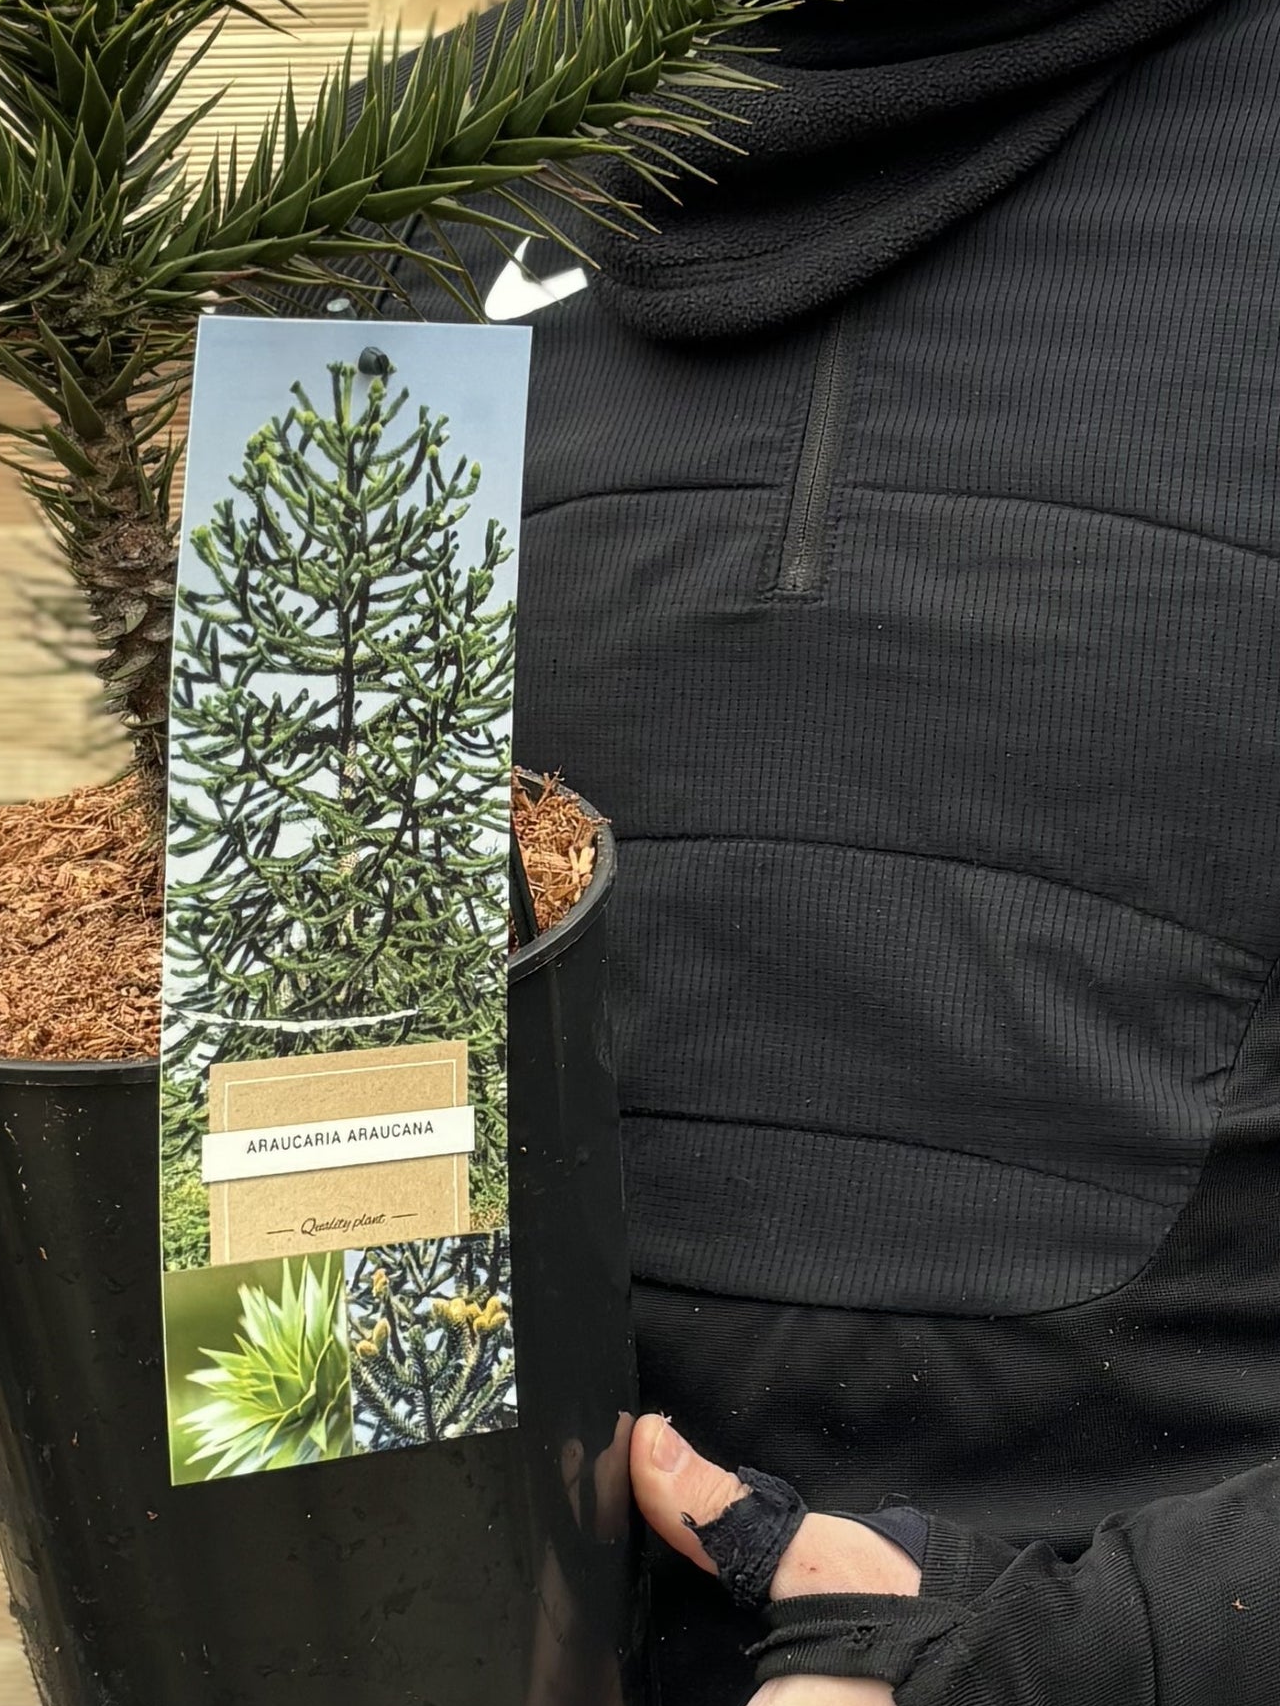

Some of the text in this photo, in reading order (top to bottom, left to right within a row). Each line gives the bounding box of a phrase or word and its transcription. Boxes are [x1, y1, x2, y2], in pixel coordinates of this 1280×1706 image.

[246, 1120, 434, 1154] ARAUCARIA ARAUCANA
[300, 1213, 386, 1236] Quality plant
